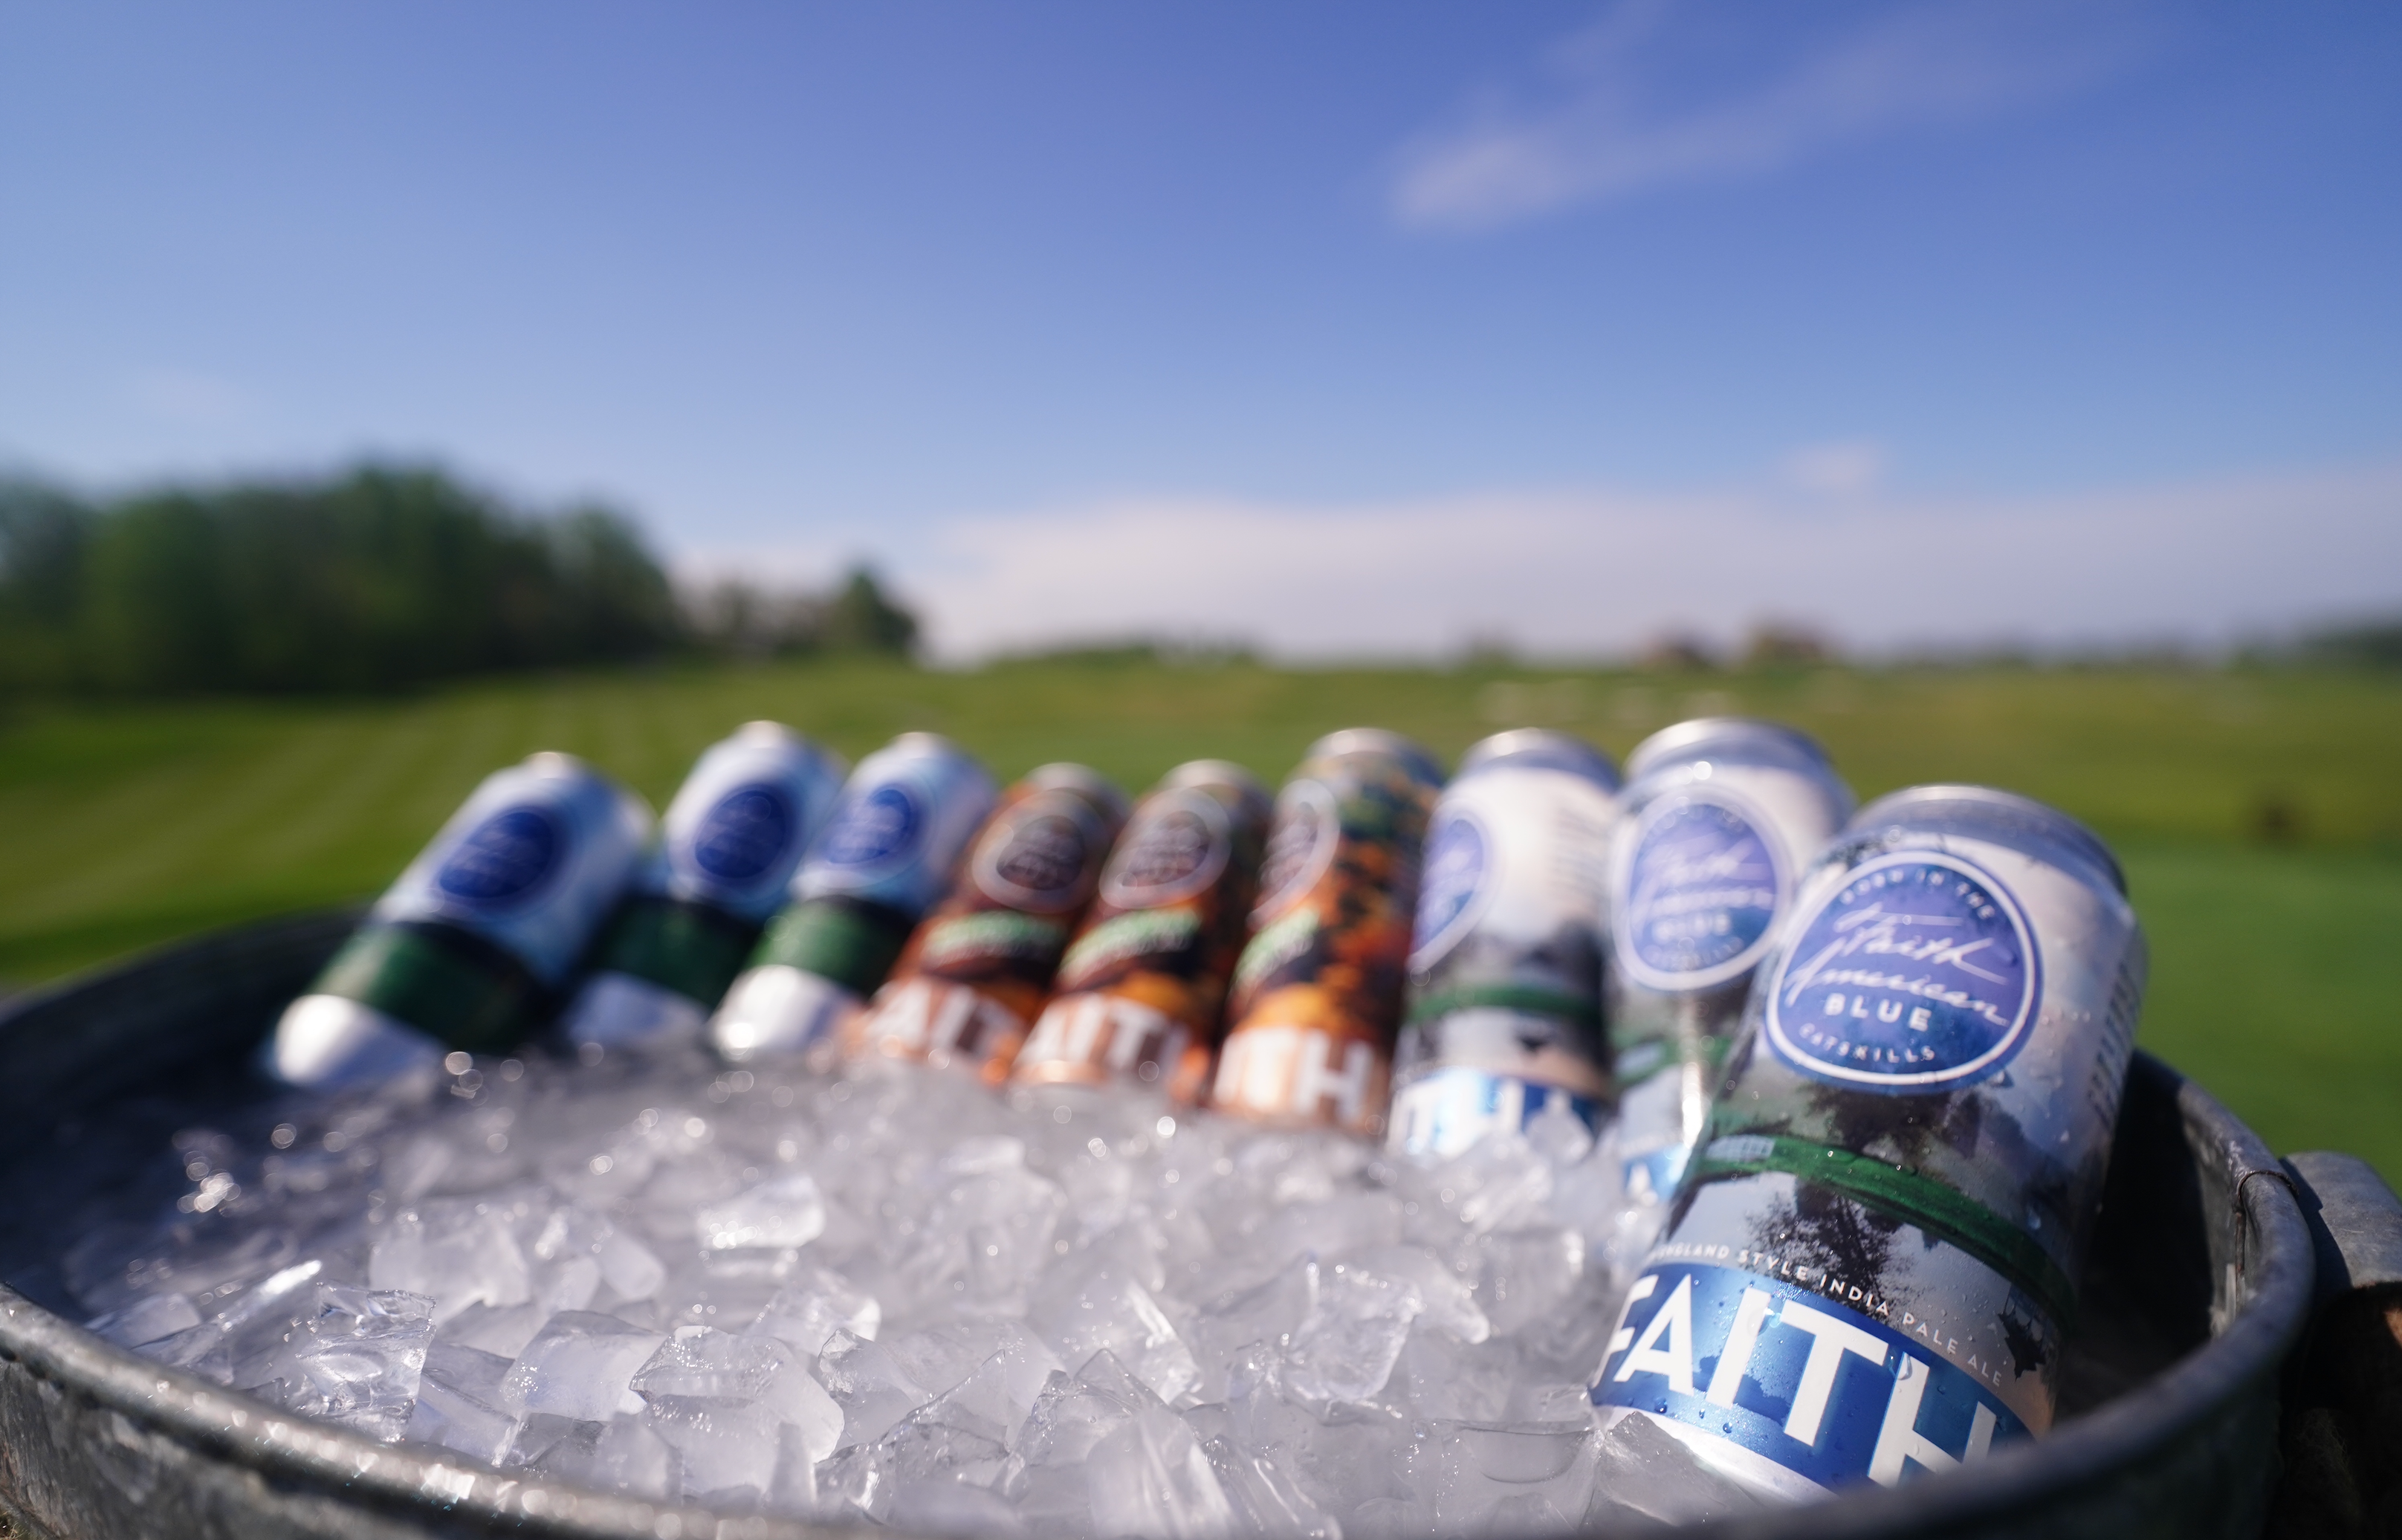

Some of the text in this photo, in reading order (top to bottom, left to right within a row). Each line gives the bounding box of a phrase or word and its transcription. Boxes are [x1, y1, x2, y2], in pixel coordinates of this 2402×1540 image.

[1799, 1023, 1936, 1064] CATSKILLS
[1824, 992, 1933, 1032] BLUE
[1738, 1249, 1808, 1281] STYLE
[1819, 1273, 1889, 1316] INDIA
[1901, 1311, 1959, 1355] PALE
[1967, 1353, 2003, 1388] ALE
[1591, 1273, 1998, 1488] FAITH
